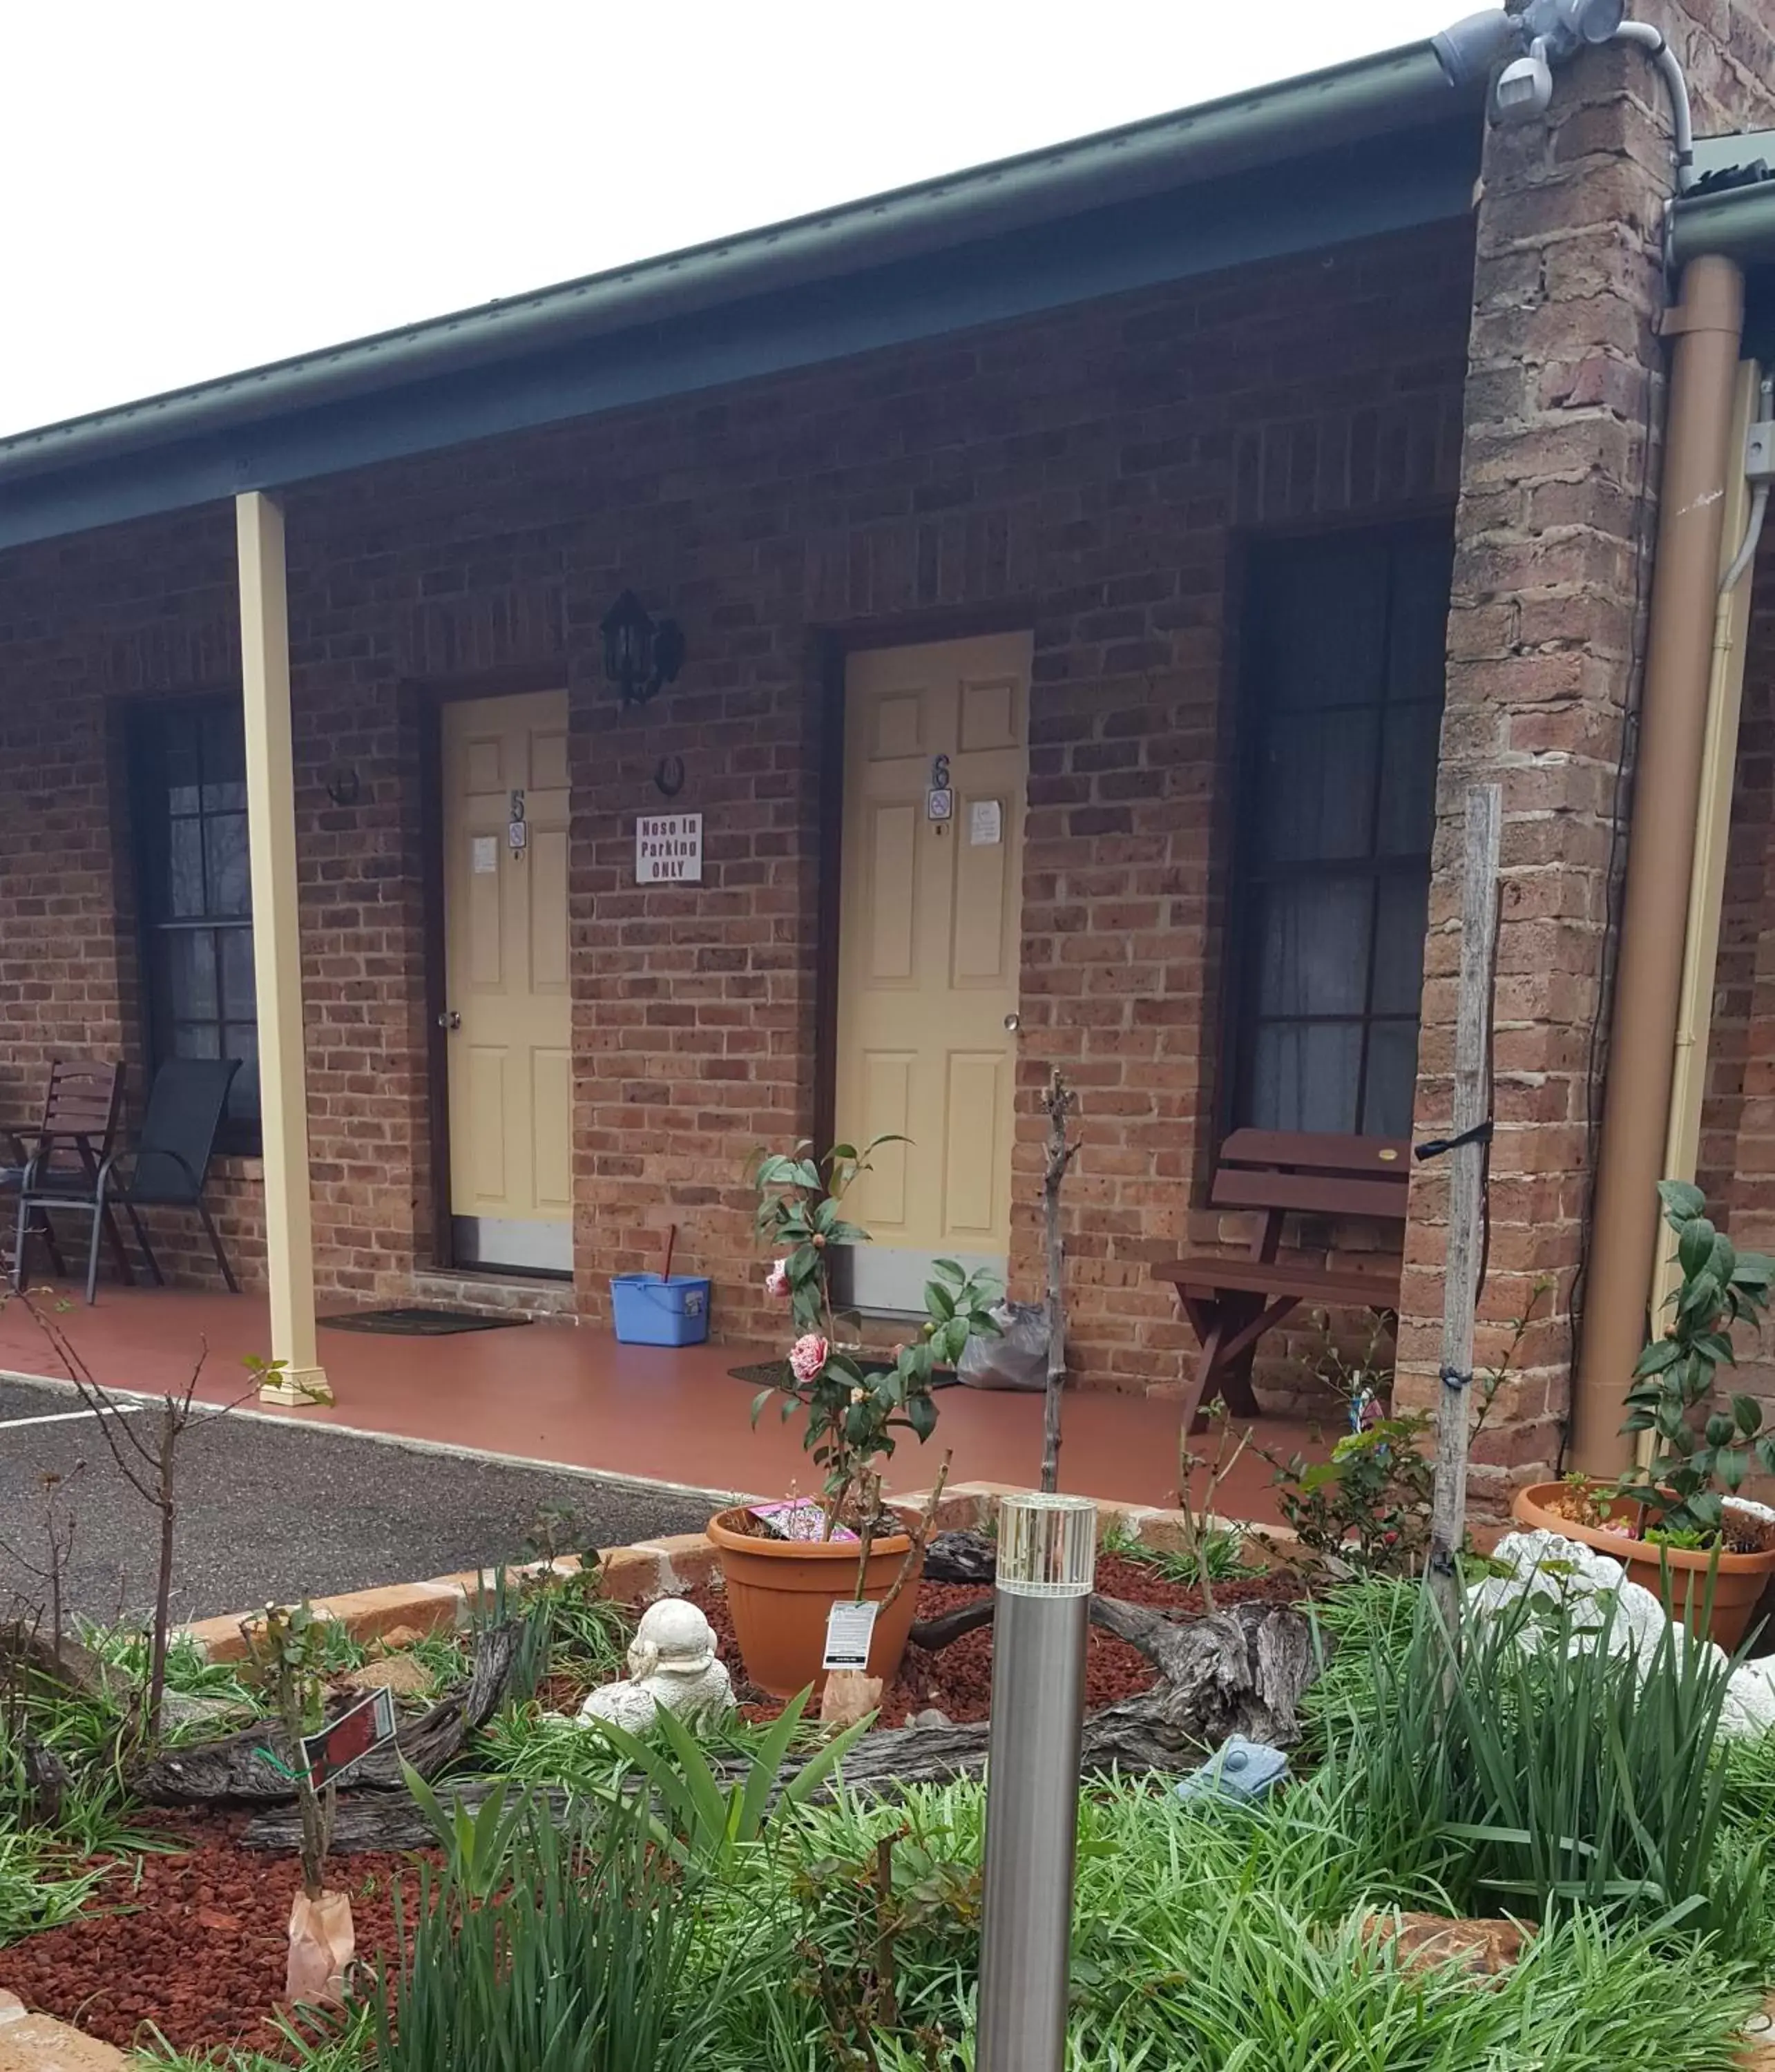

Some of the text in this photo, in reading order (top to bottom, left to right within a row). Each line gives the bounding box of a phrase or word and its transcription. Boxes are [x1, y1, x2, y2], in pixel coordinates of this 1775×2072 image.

[932, 754, 950, 789] 6
[511, 790, 524, 821] 5
[642, 820, 676, 836] Nose
[642, 840, 697, 858] Parking
[652, 861, 685, 878] ONLY
